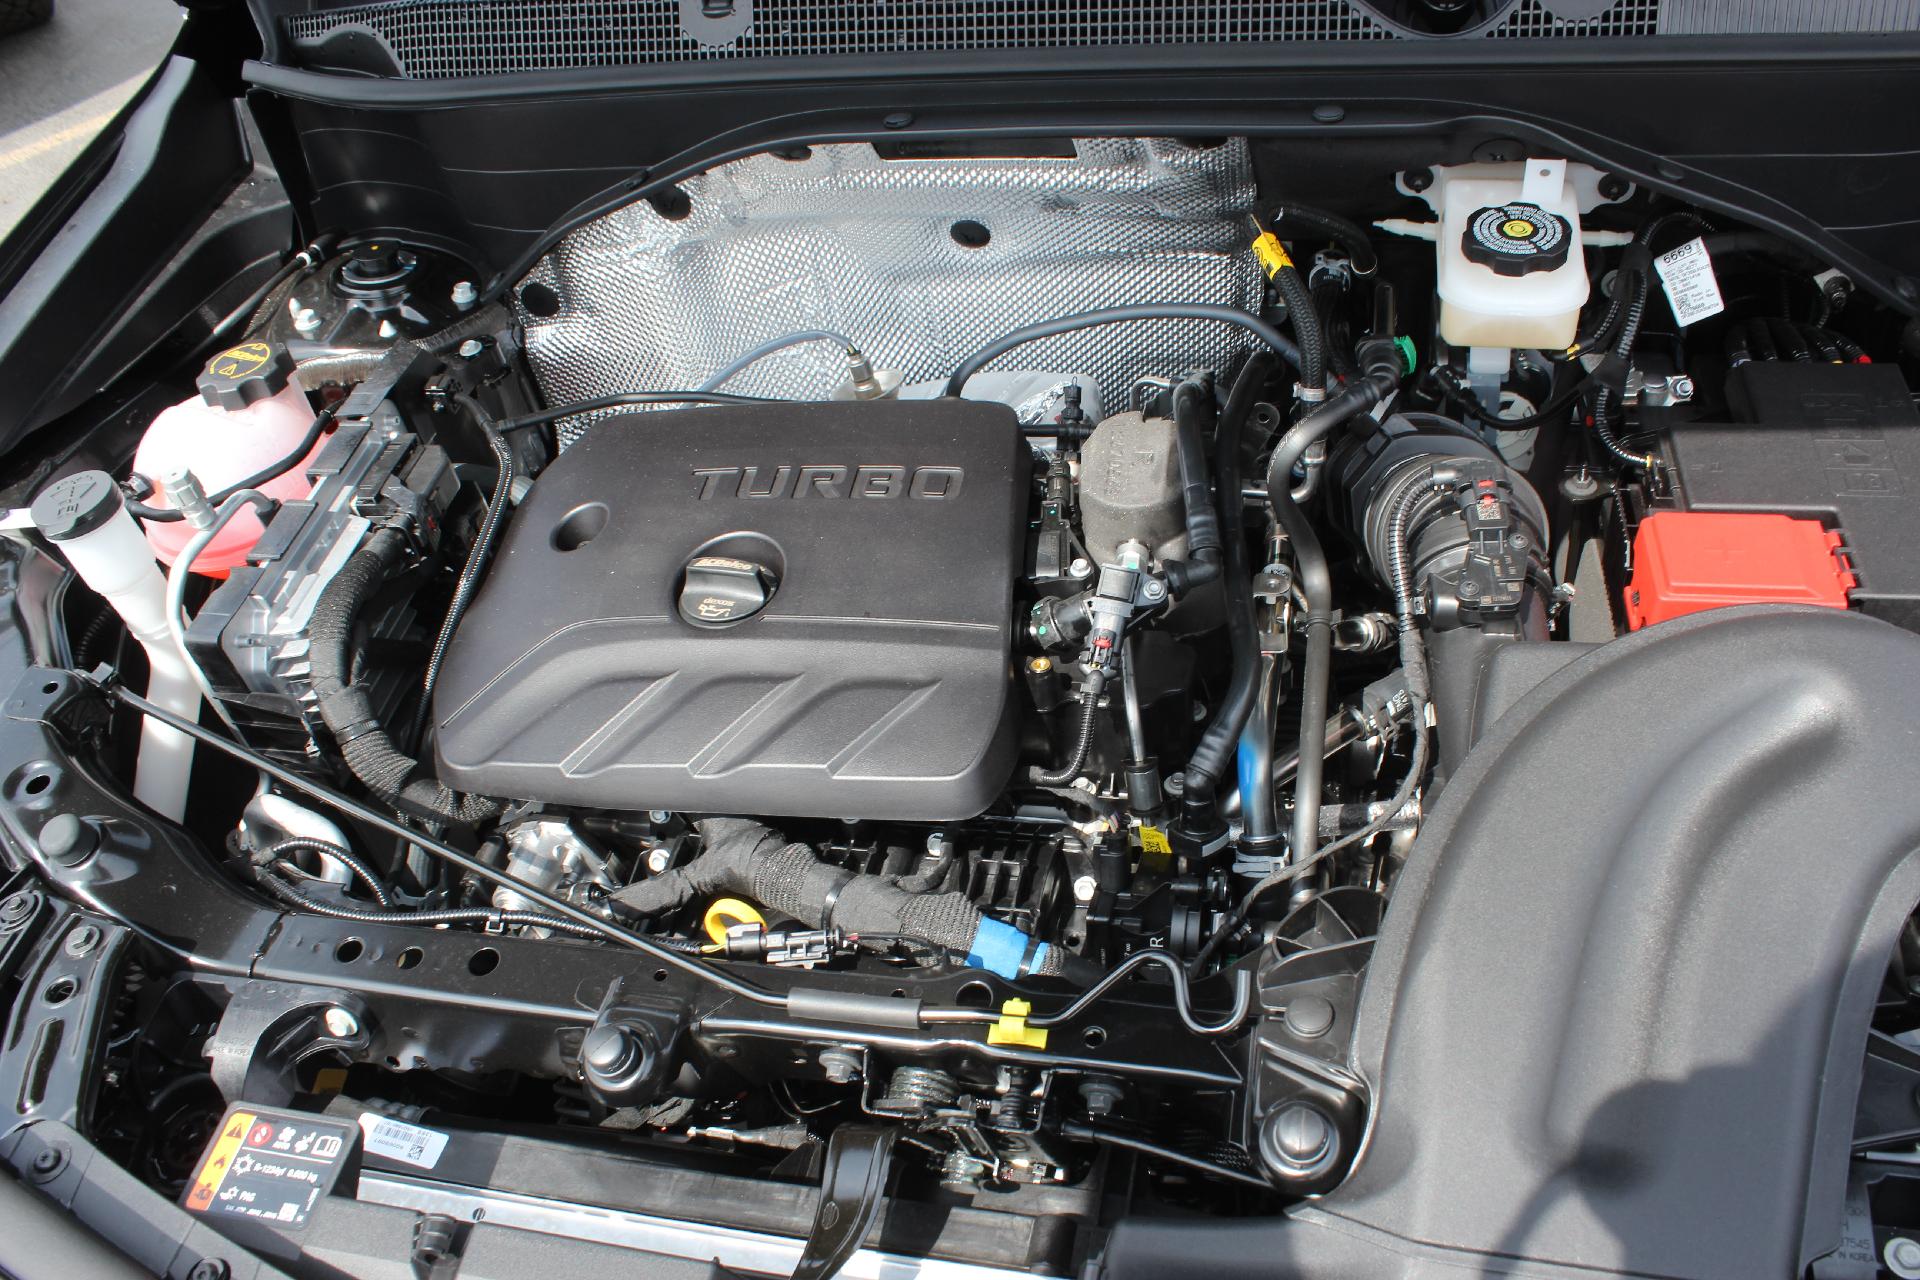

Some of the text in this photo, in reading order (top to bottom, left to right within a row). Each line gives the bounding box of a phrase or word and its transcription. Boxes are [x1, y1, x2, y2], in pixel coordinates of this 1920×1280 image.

[1663, 243, 1692, 264] 6669
[692, 465, 964, 500] TURBO
[693, 558, 753, 570] ACDelco
[703, 597, 736, 607] dexos
[1149, 937, 1164, 948] R
